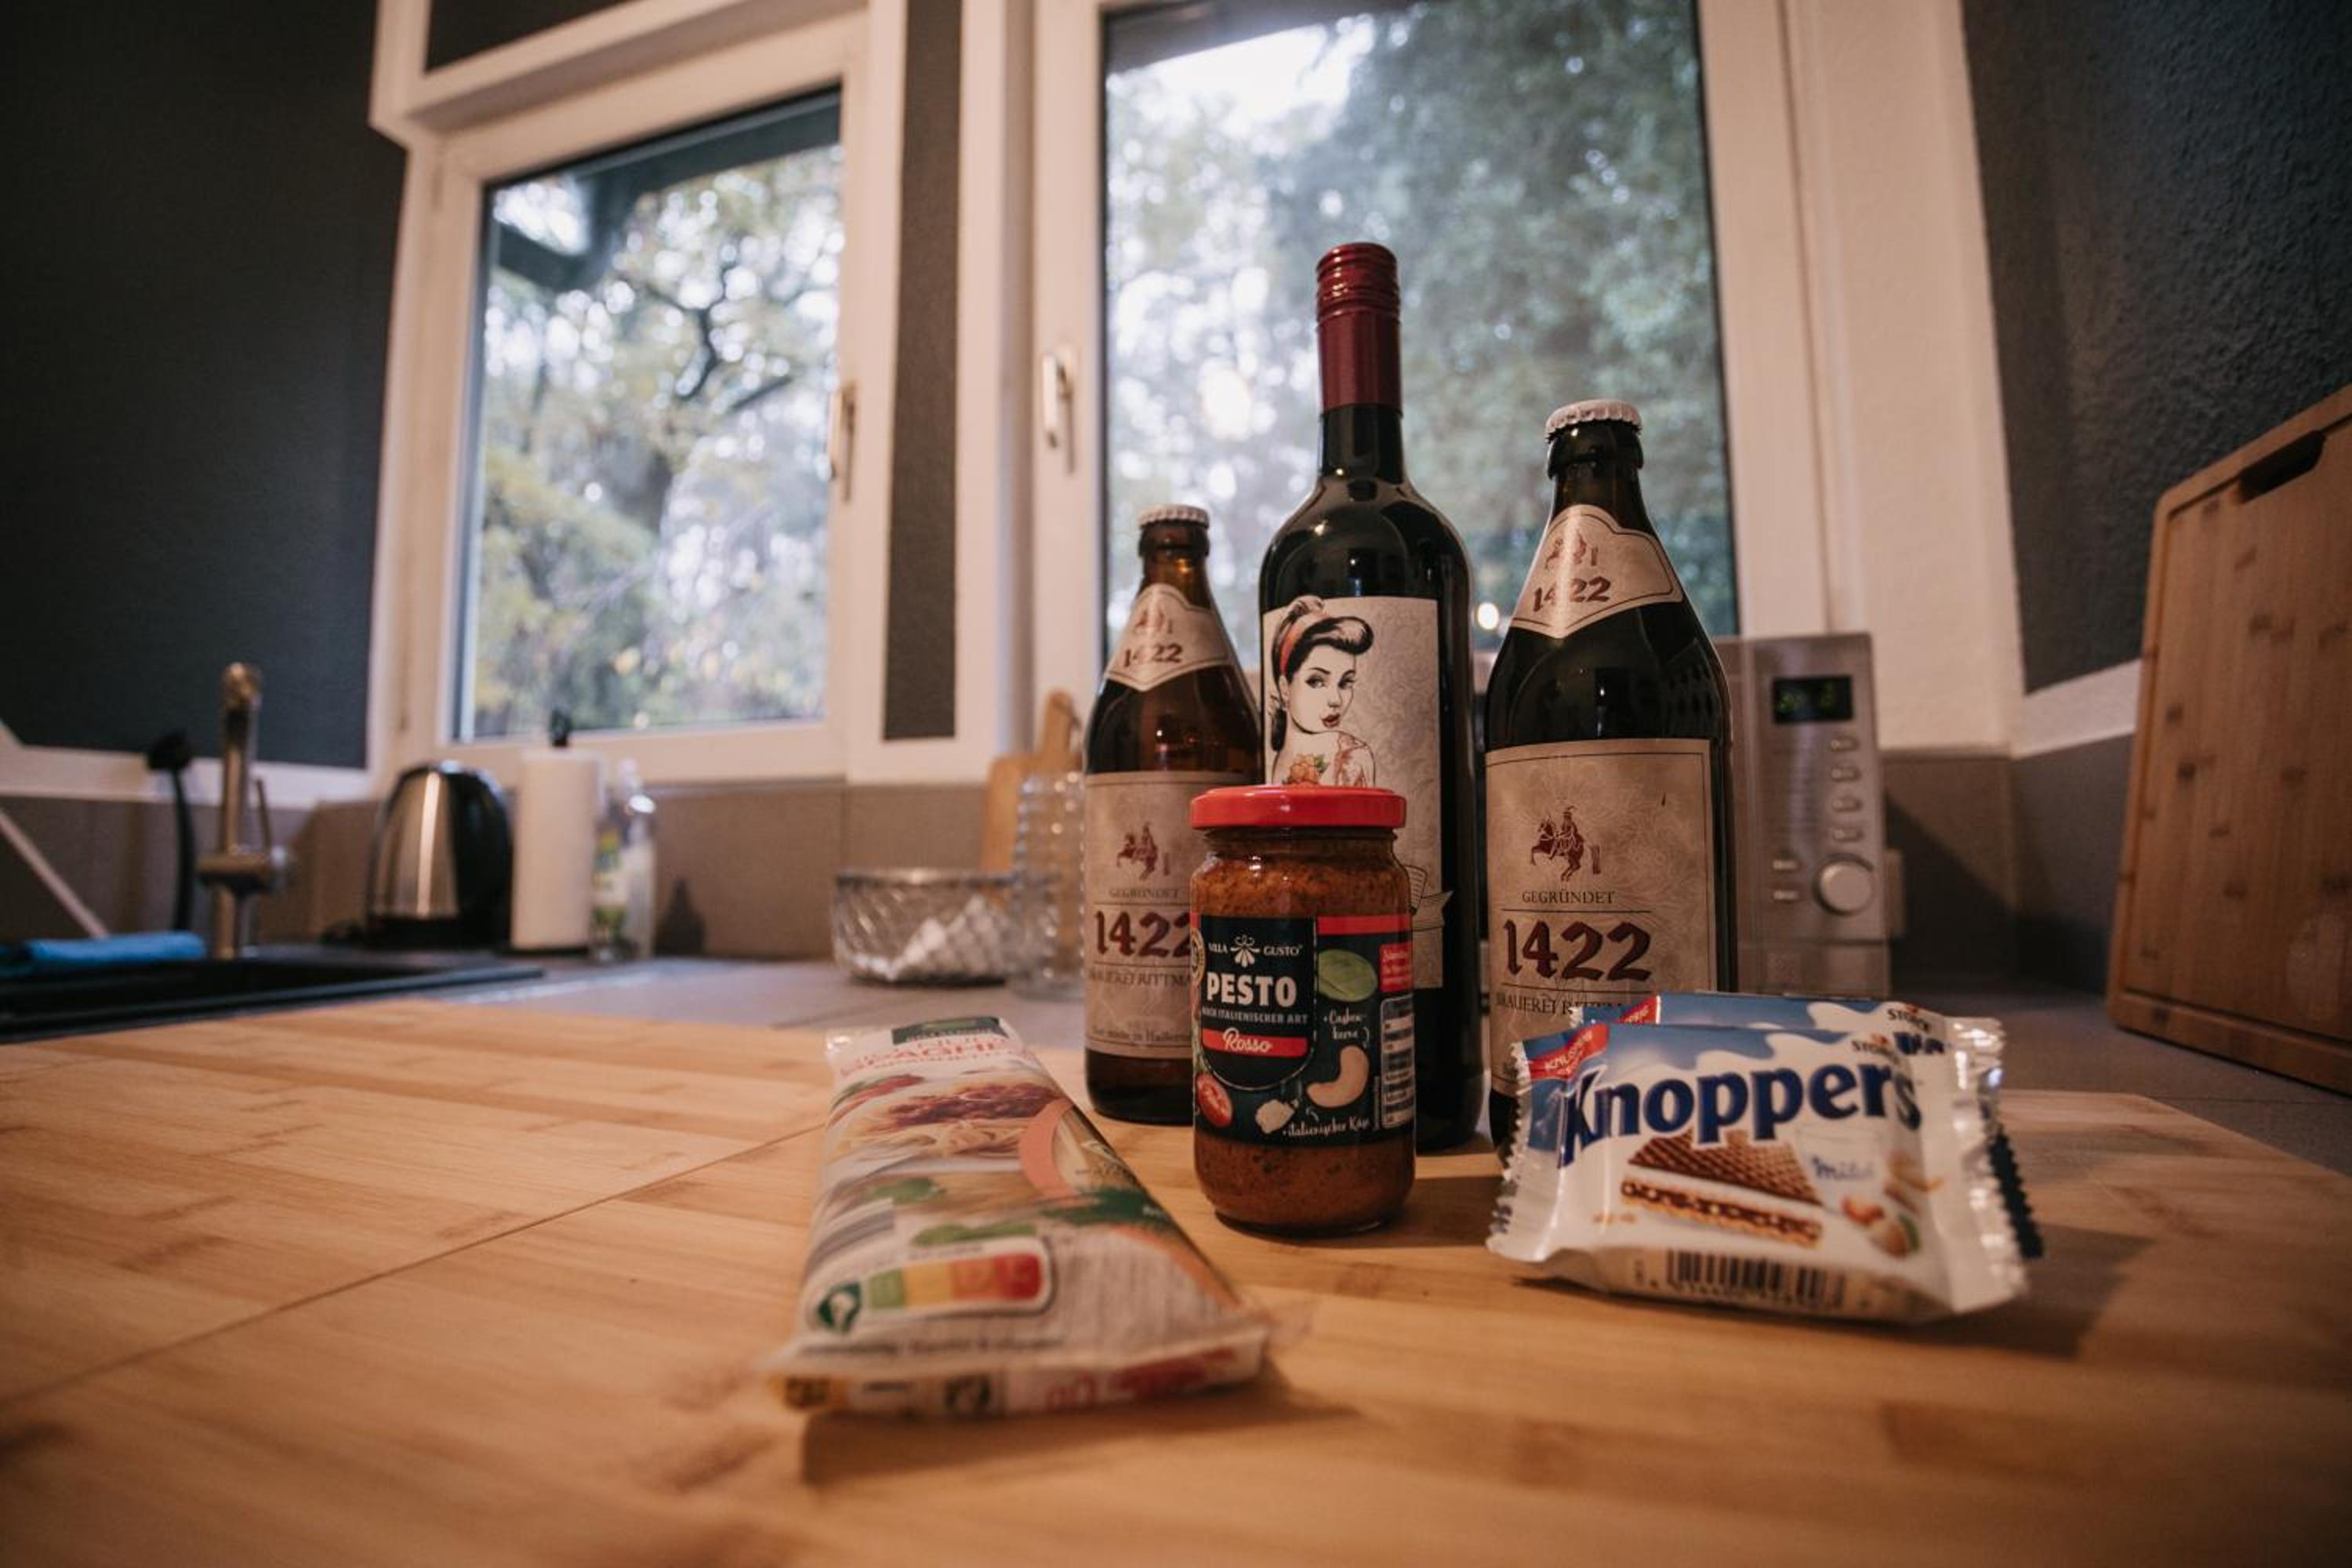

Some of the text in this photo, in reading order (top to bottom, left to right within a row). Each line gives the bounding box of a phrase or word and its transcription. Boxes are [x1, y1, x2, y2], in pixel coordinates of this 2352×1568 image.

[1522, 887, 1615, 904] GEGRÜNDET
[1208, 942, 1299, 956] VILLA GUSTO
[1503, 918, 1653, 982] 1422
[1206, 971, 1298, 1008] PESTO
[1287, 1014, 1308, 1024] ART
[1222, 1027, 1272, 1053] Rosso
[1557, 1063, 1921, 1169] Knoppers
